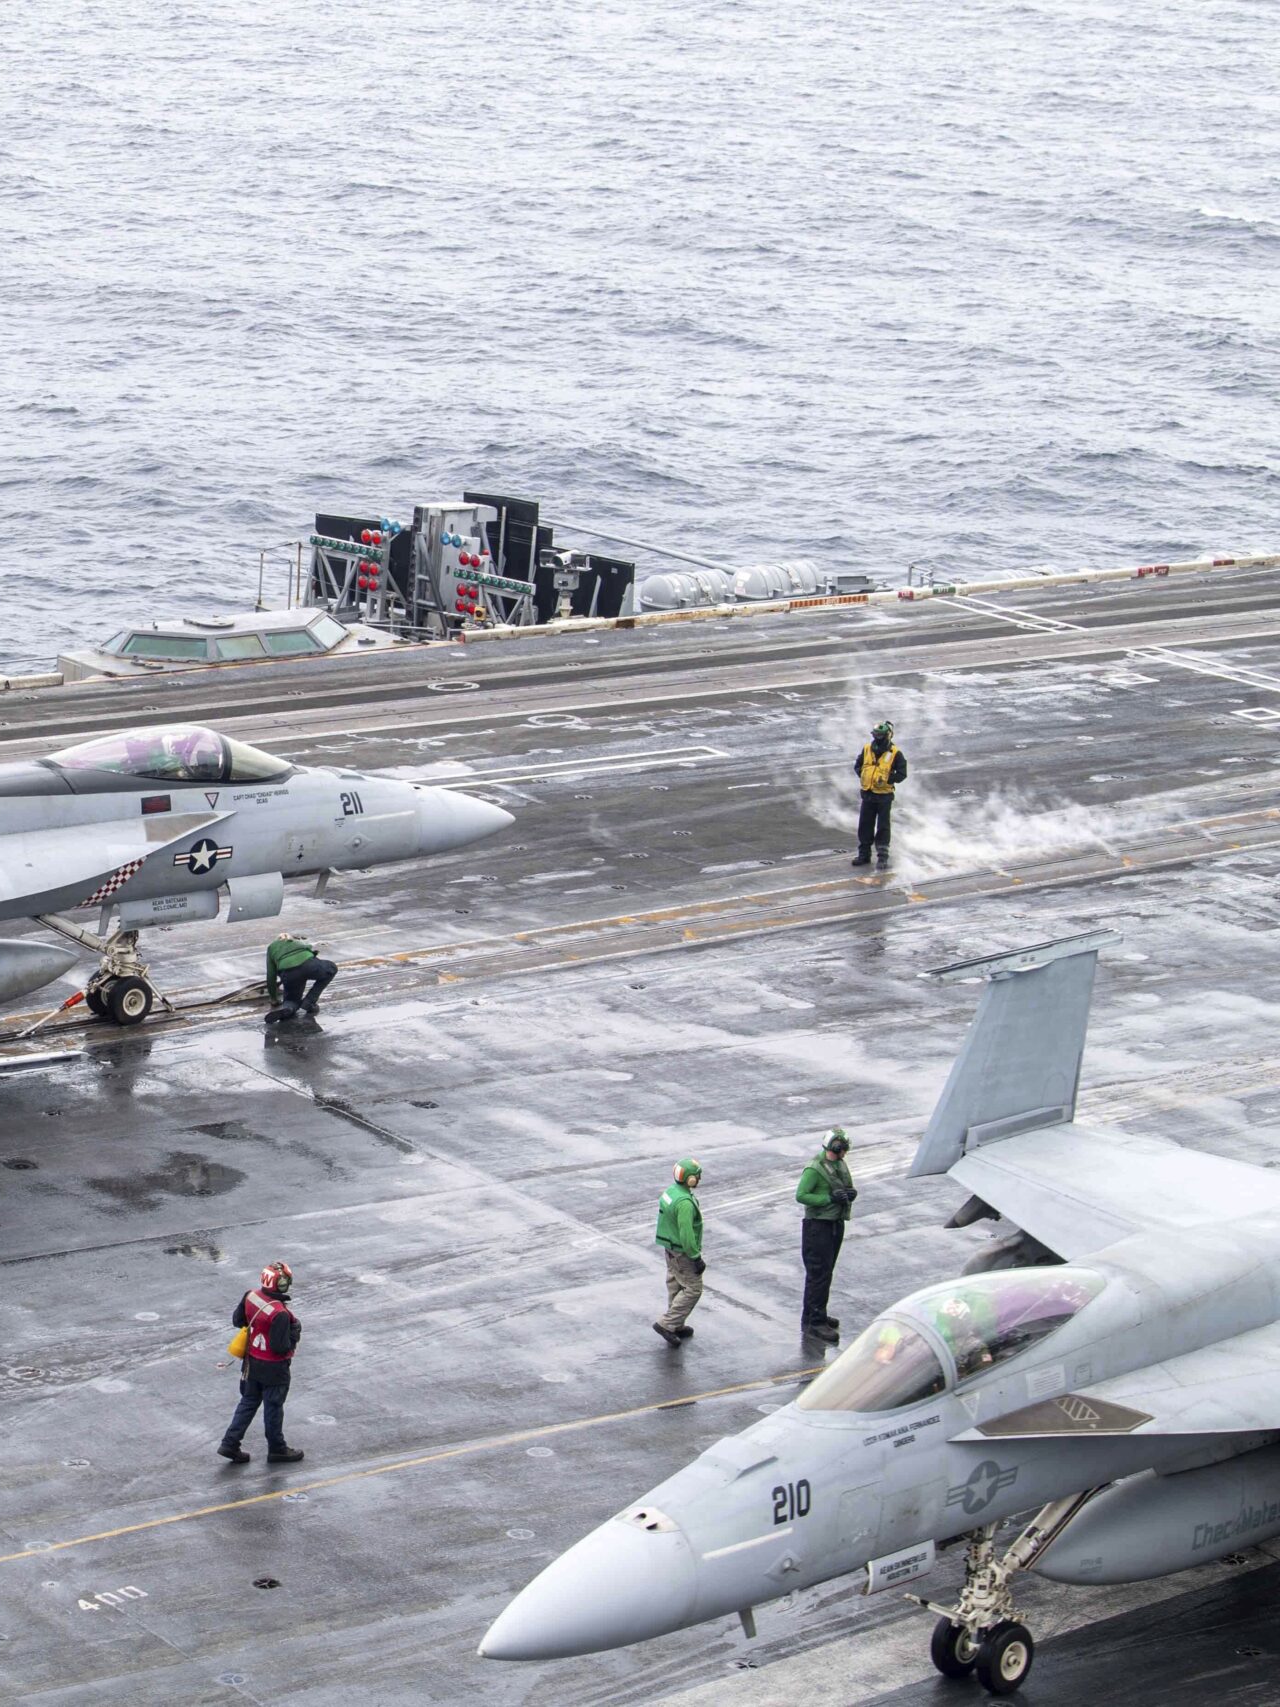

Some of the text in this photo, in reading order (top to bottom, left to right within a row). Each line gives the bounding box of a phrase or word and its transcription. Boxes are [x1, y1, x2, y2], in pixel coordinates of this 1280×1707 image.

[340, 791, 364, 816] 211
[772, 1478, 811, 1525] 210
[78, 1585, 149, 1610] 400
